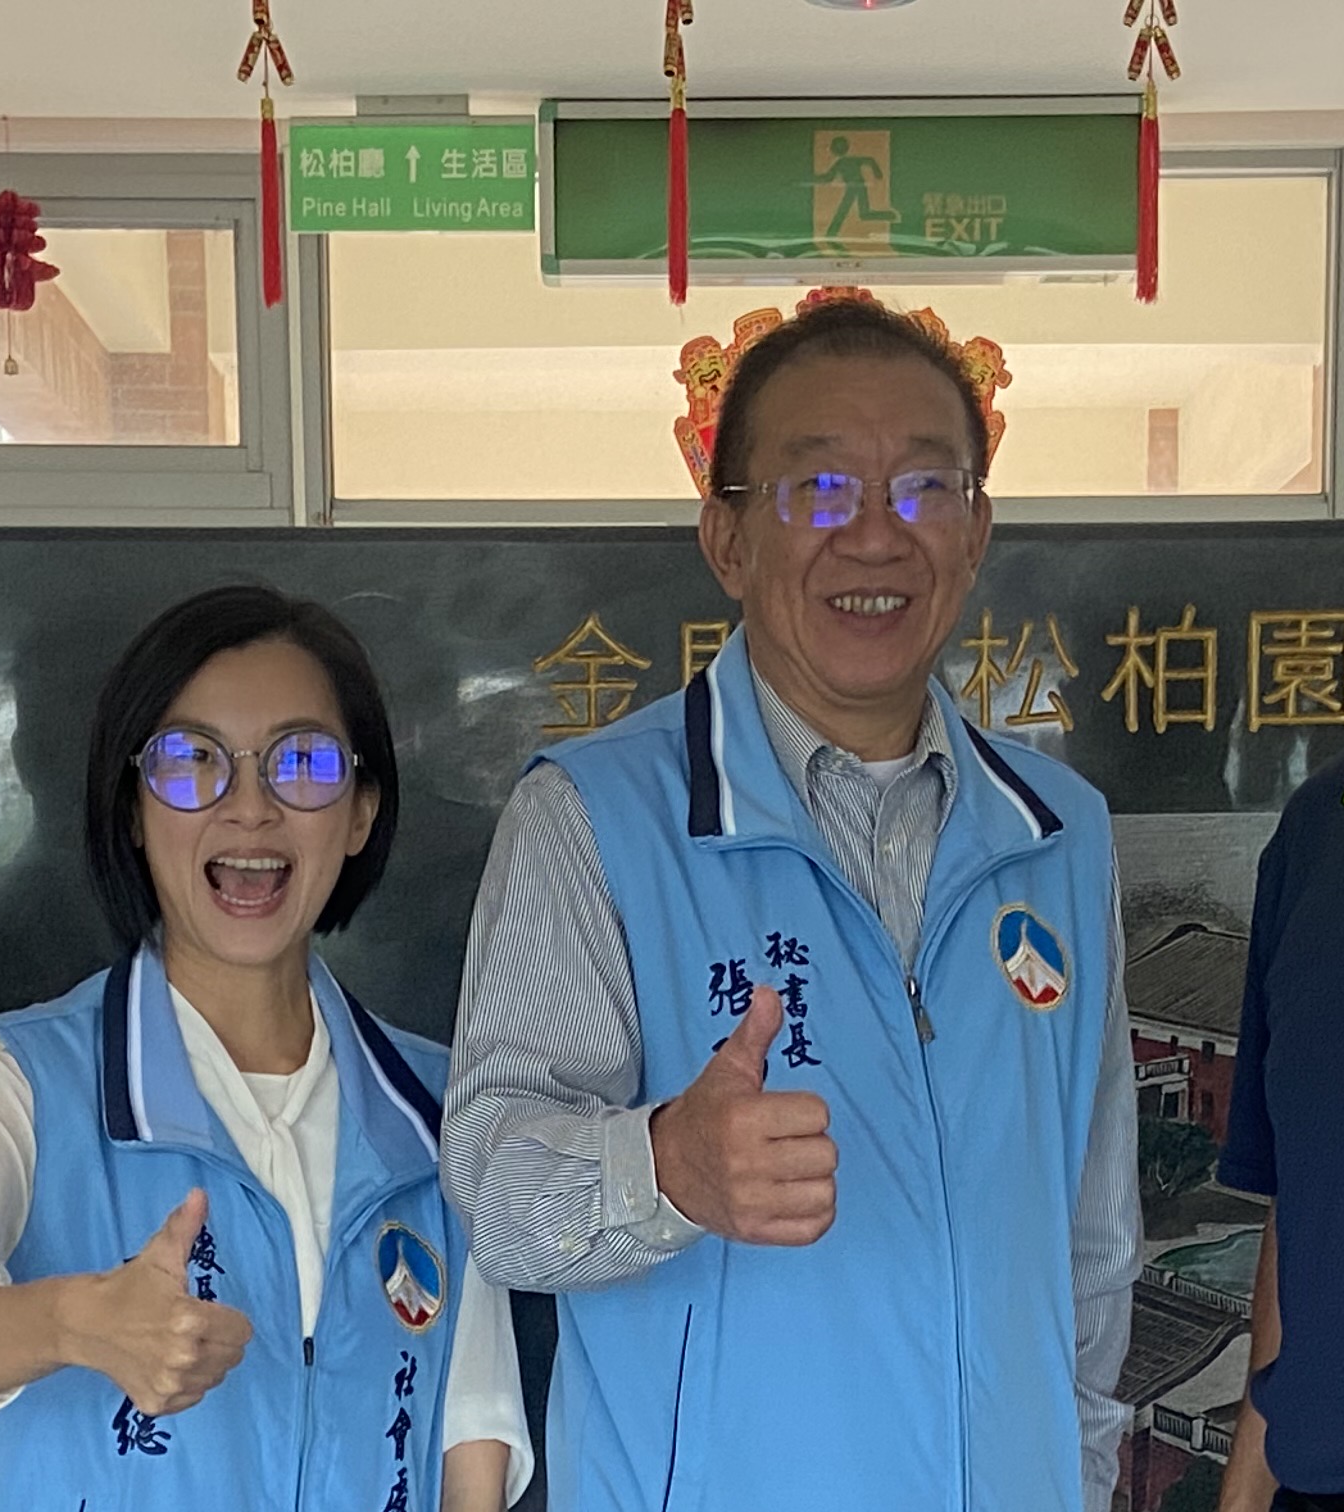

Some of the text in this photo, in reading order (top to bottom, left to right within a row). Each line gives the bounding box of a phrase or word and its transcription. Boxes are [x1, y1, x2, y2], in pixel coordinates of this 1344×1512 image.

[299, 147, 527, 178] 松柏廳 生活區
[302, 197, 524, 222] Pine Hall Living Area
[925, 217, 1004, 242] EXIT
[764, 932, 822, 1069] 秘書長
